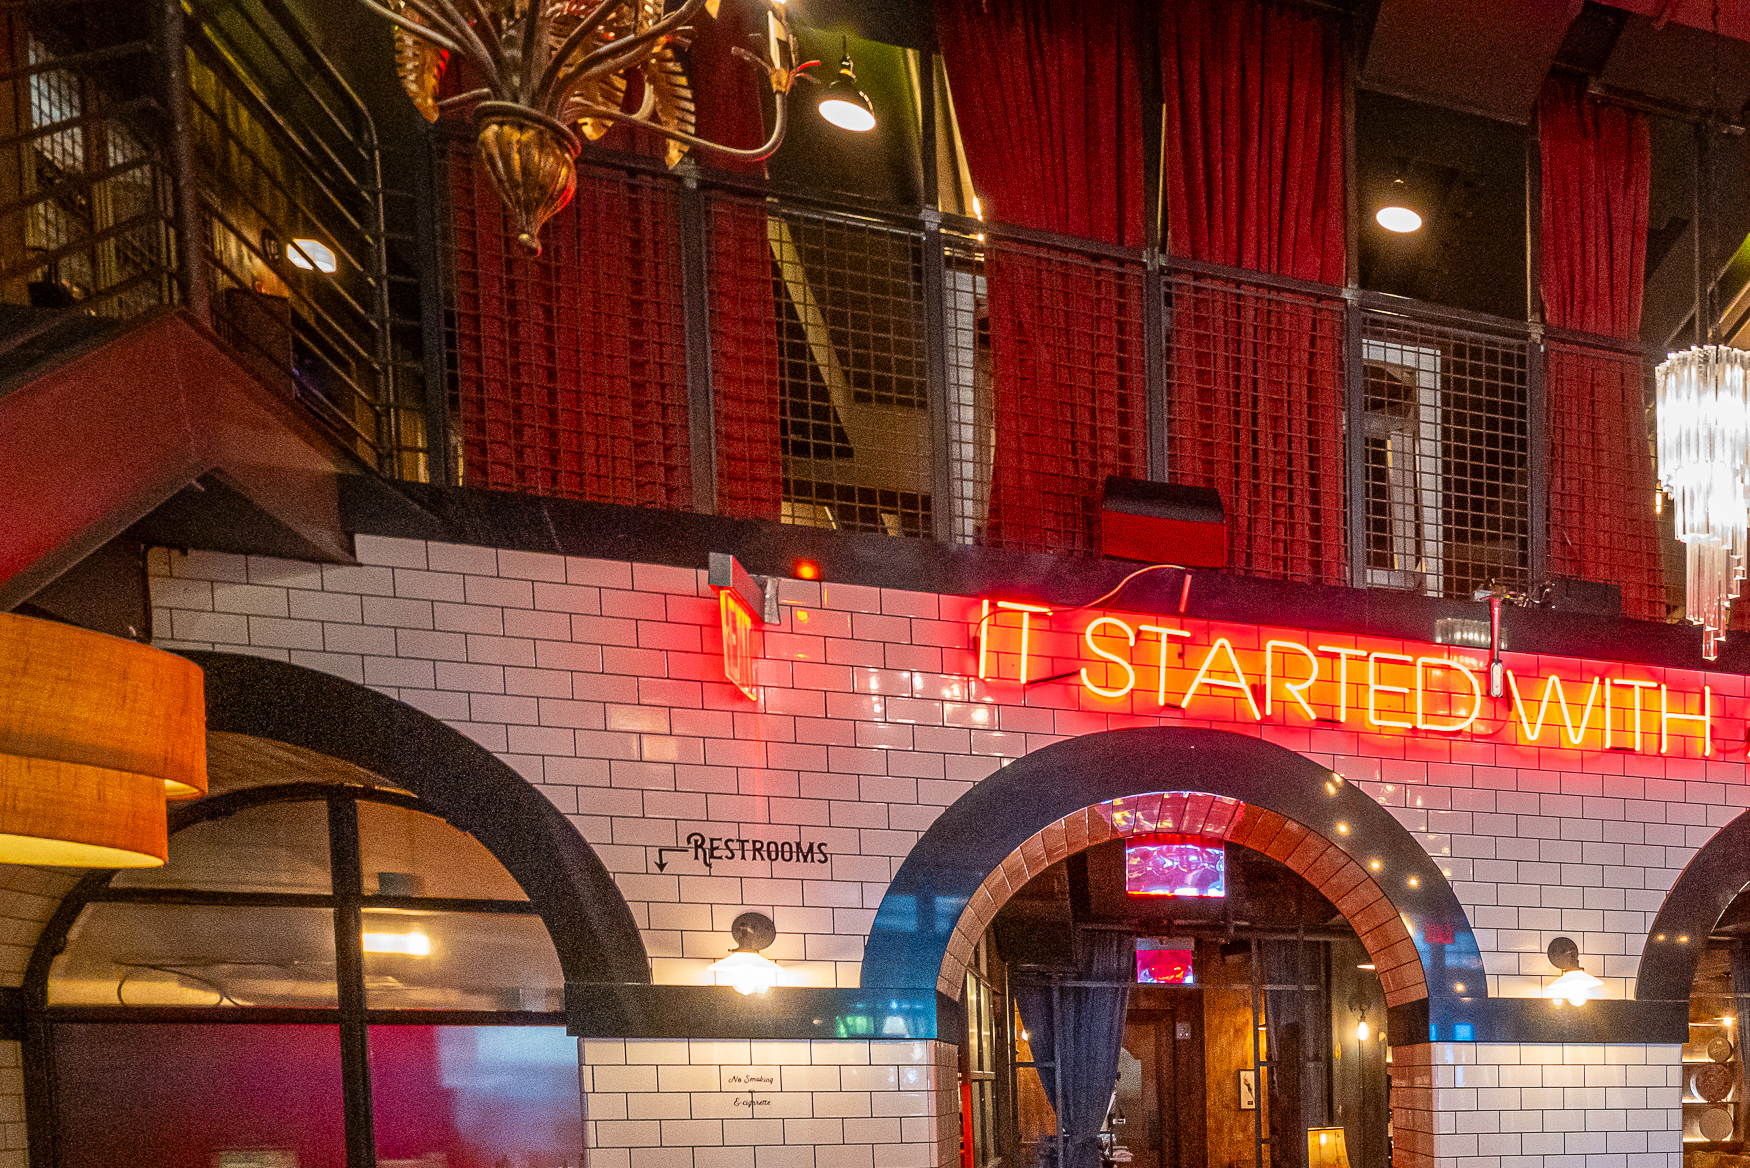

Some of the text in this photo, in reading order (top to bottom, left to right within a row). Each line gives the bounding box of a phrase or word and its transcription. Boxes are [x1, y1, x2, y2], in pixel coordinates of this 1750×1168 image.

[977, 598, 1053, 685] IT
[1080, 616, 1482, 732] STARTED
[1506, 668, 1711, 758] WITH
[728, 1074, 774, 1085] No Smoking
